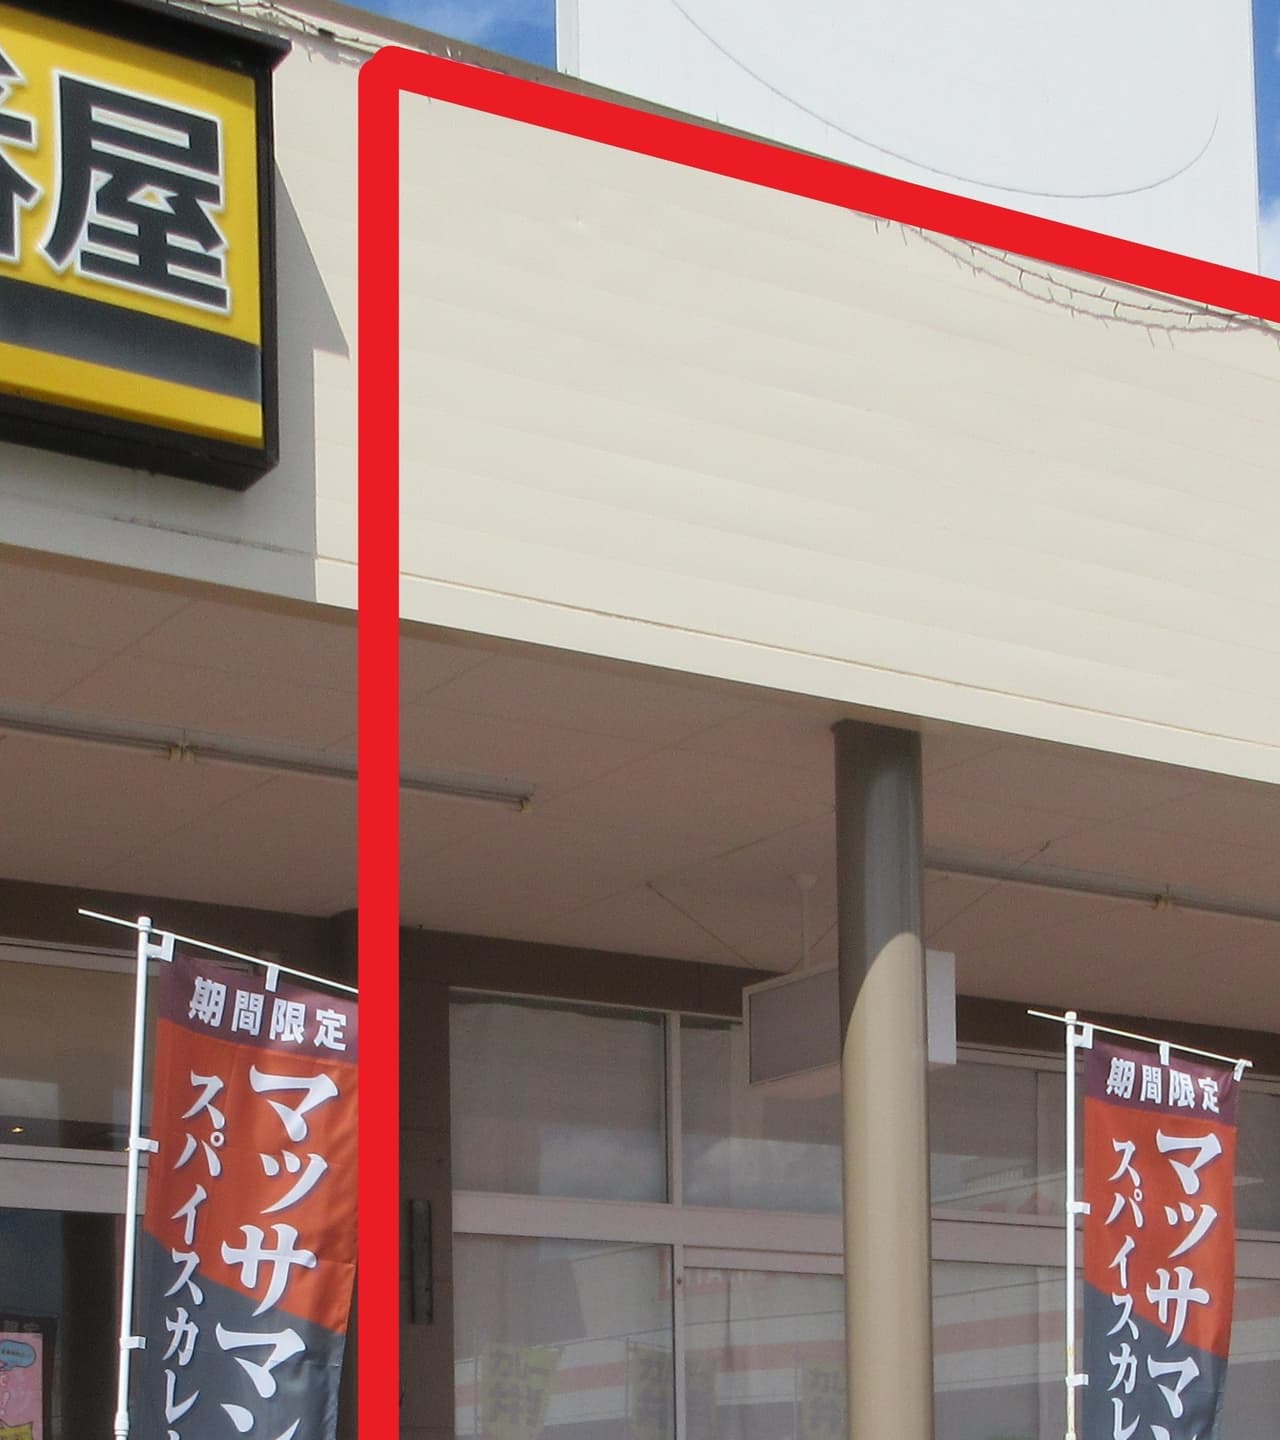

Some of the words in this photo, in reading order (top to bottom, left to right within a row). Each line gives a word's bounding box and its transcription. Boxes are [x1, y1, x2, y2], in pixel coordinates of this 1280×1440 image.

[188, 975, 348, 1051] 期間限定
[1106, 1057, 1220, 1113] 期間限定
